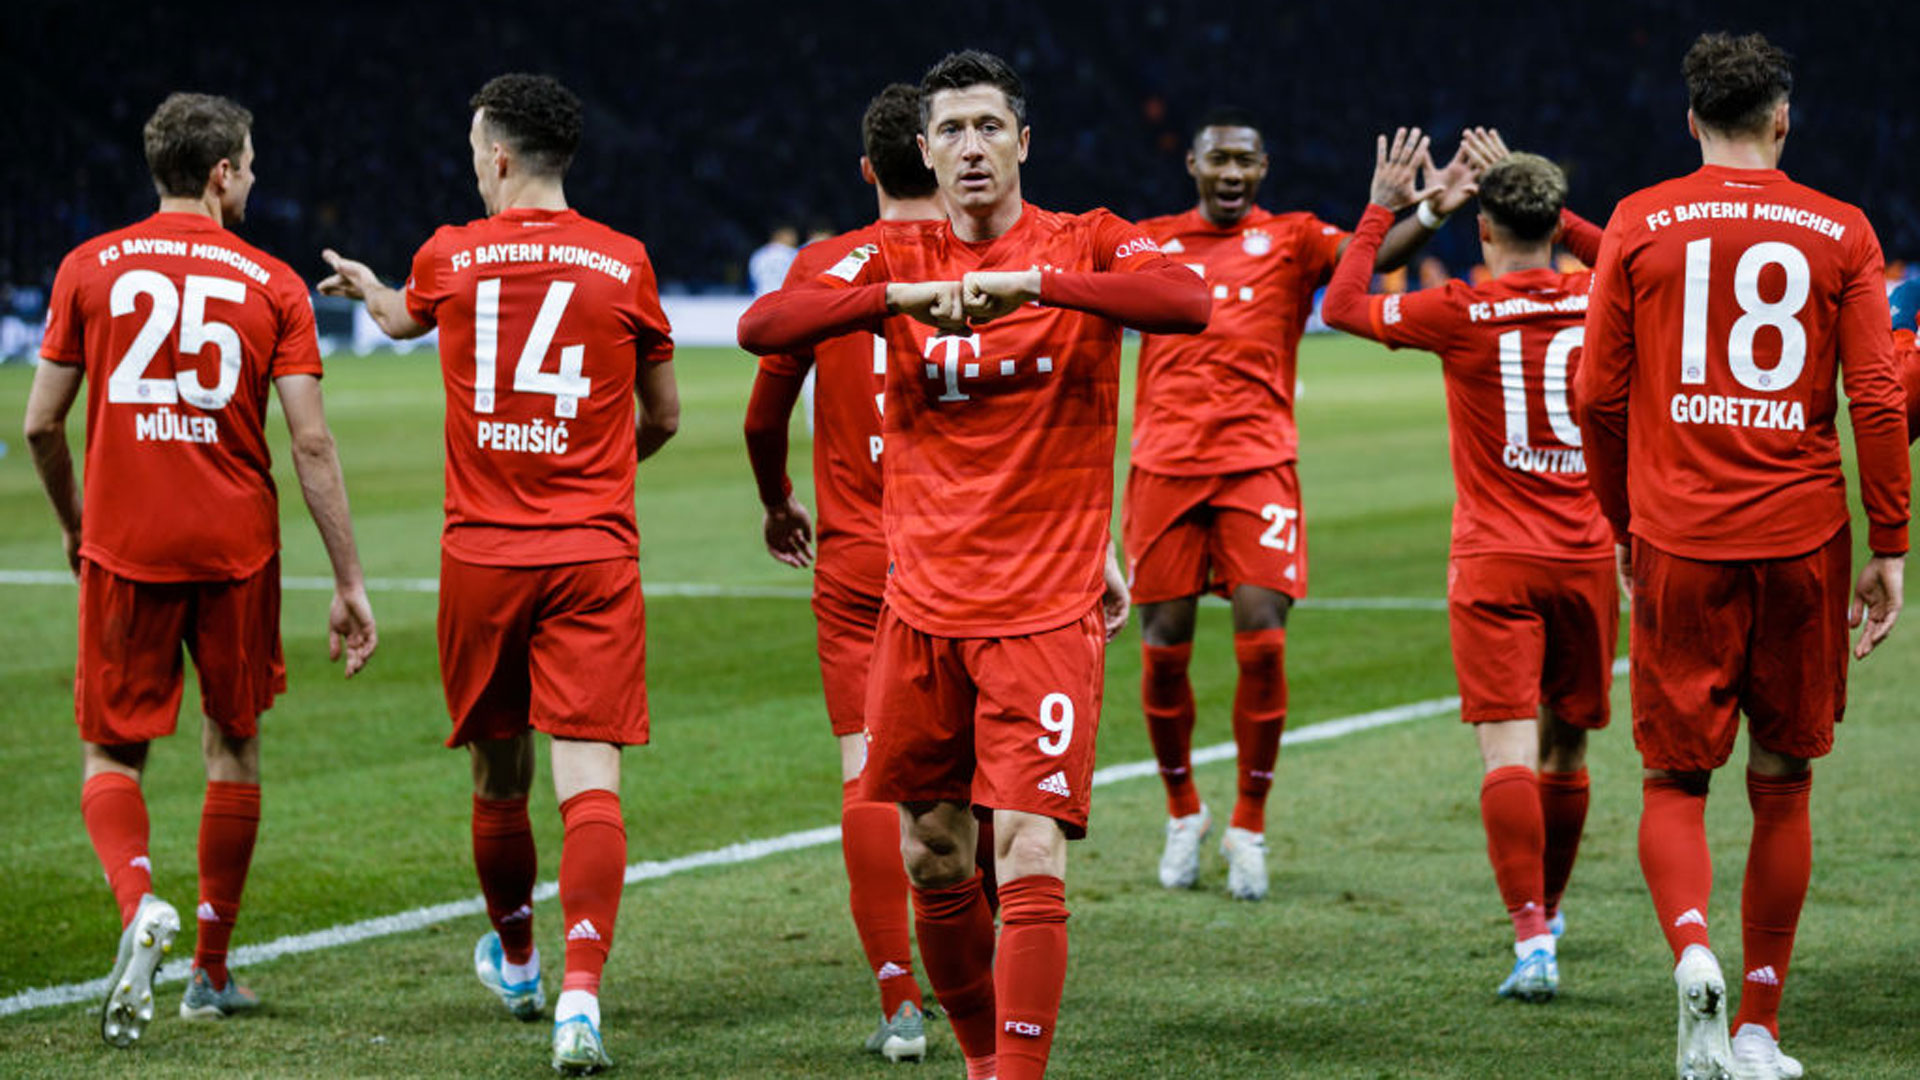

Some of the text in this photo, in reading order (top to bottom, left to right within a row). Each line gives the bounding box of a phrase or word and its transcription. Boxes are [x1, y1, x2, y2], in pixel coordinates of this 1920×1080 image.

[1646, 210, 1671, 232] FC
[1674, 202, 1748, 222] BAYERN
[99, 245, 120, 267] FC
[122, 238, 188, 256] BAYERN
[451, 250, 472, 273] FC
[475, 243, 544, 264] BAYERN
[1469, 301, 1492, 323] FC
[1681, 237, 1811, 392] 18
[108, 269, 247, 411] 25
[474, 277, 592, 420] 14
[1499, 325, 1586, 447] 10
[136, 407, 219, 444] MÜLLER
[1670, 393, 1806, 431] GORETZKA
[477, 418, 569, 455] PERIŠIĆ
[1503, 444, 1588, 474] COUTIN
[1259, 503, 1298, 555] 27
[1037, 692, 1075, 757] 9
[1004, 1021, 1042, 1036] FCB
